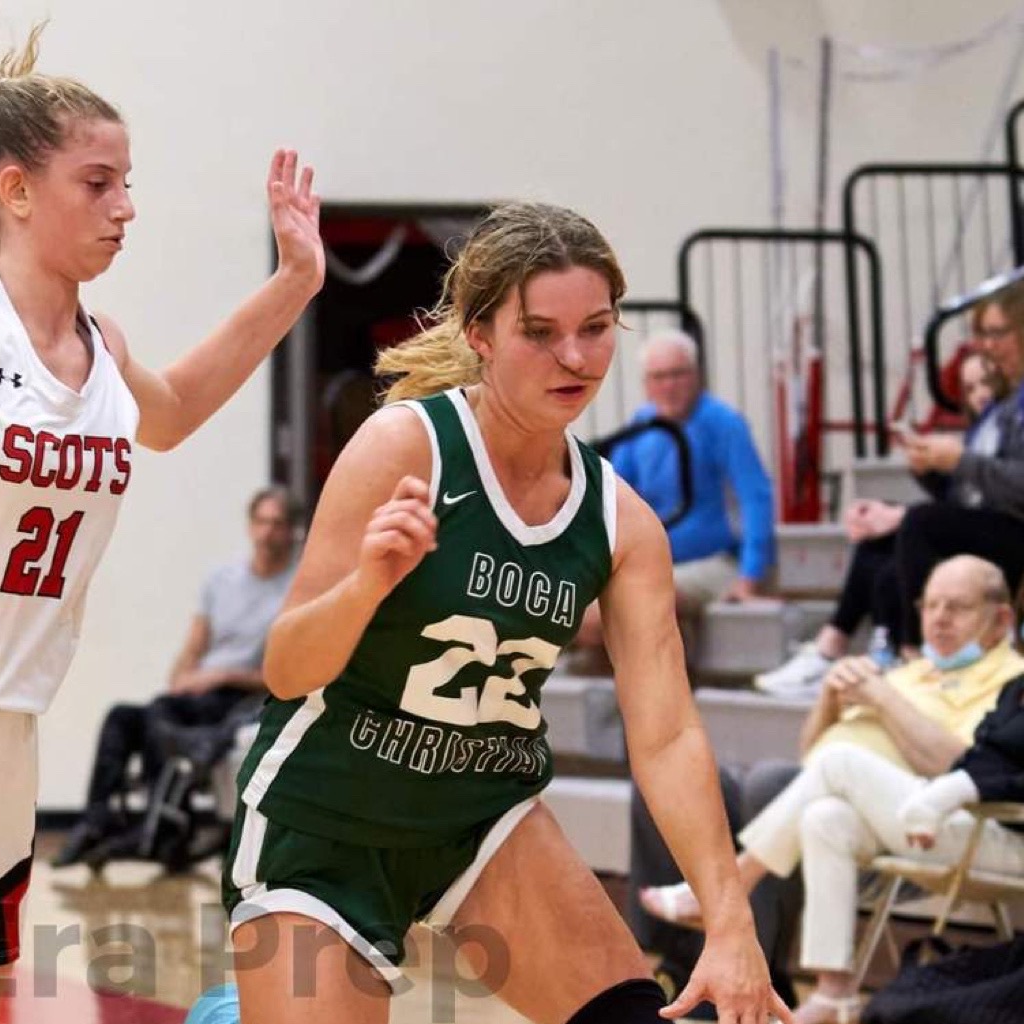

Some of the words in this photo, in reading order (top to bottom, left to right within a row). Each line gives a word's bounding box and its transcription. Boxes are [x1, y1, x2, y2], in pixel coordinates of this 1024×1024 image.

[0, 506, 85, 599] 21
[466, 552, 576, 627] BOCA
[399, 614, 562, 729] 22
